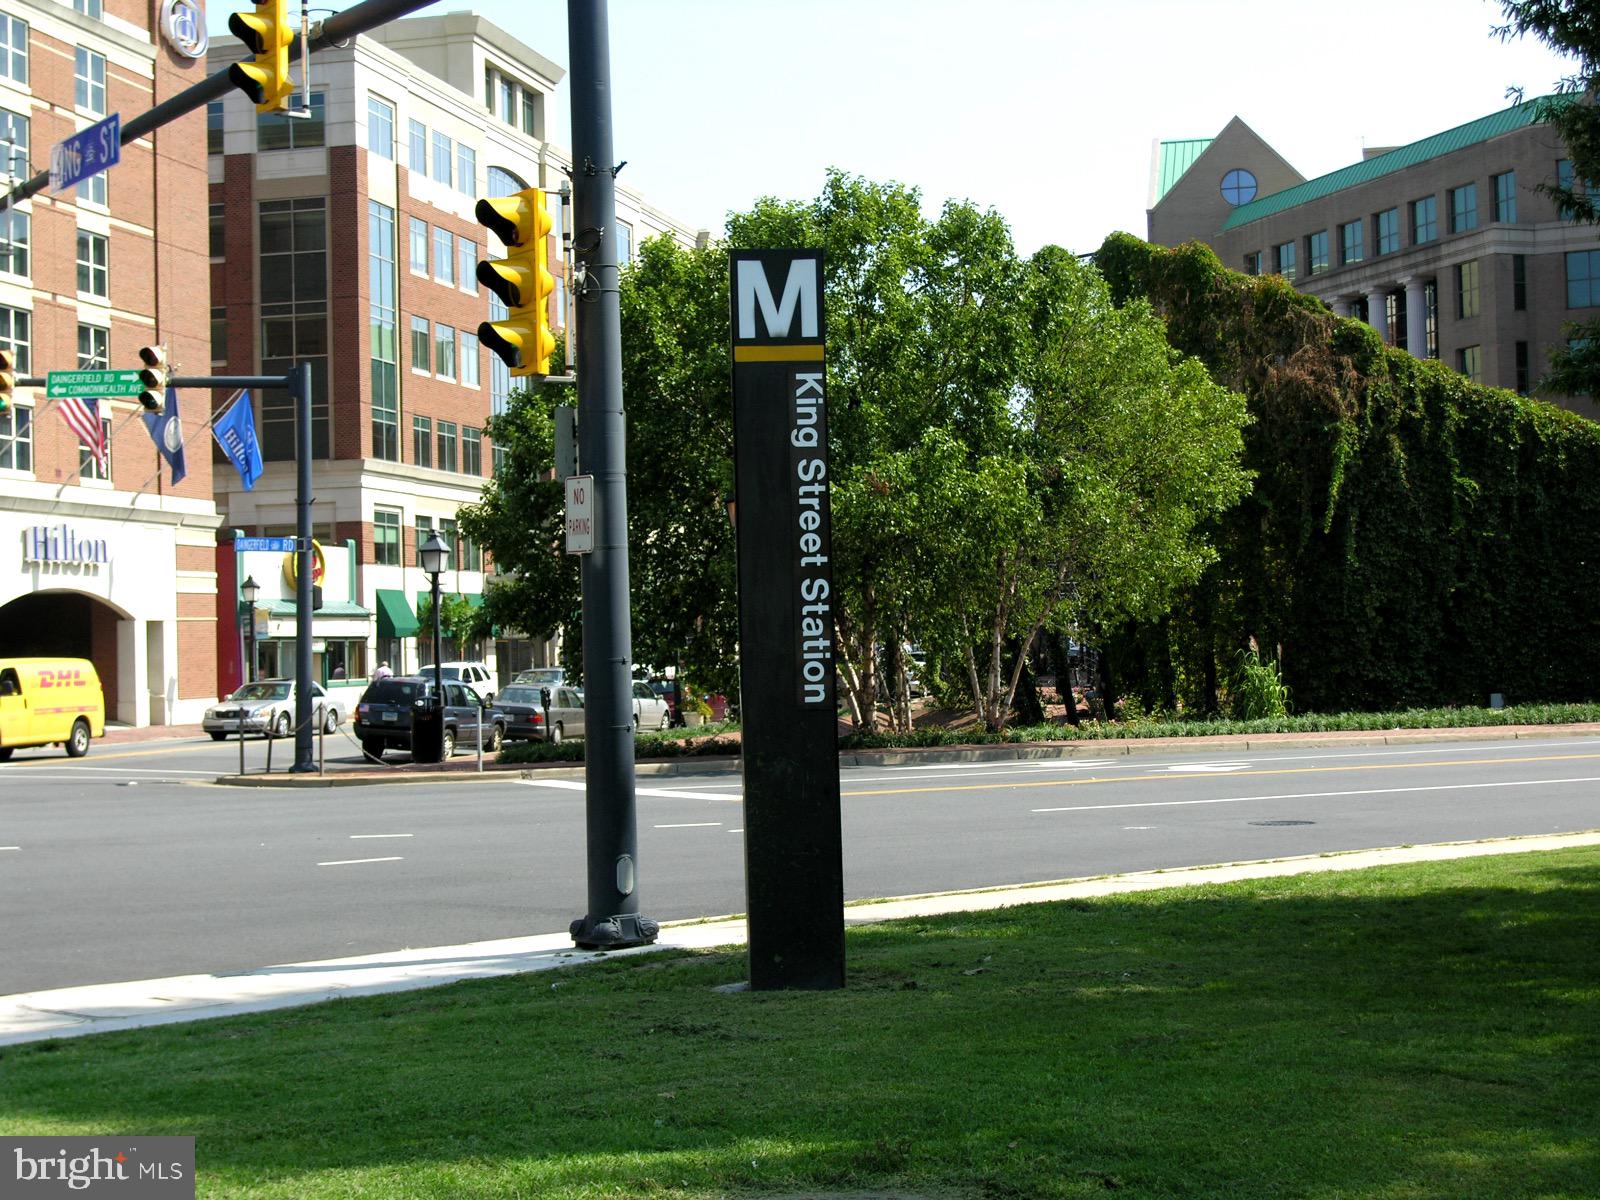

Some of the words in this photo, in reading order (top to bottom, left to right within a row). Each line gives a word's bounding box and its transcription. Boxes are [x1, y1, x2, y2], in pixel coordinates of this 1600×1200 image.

[100, 121, 116, 163] ST
[737, 259, 818, 339] M
[51, 374, 102, 385] DAINGERFIELD
[103, 374, 115, 383] RD
[68, 384, 126, 395] COMMONWEALTH
[128, 384, 142, 394] AVE
[791, 373, 824, 448] King
[223, 428, 249, 474] Hilto
[573, 488, 585, 504] NO
[797, 458, 828, 567] Street
[22, 524, 108, 563] Hilton
[282, 540, 294, 552] RD
[569, 518, 590, 536] PARKING
[801, 578, 831, 704] Station
[38, 670, 86, 688] DHL
